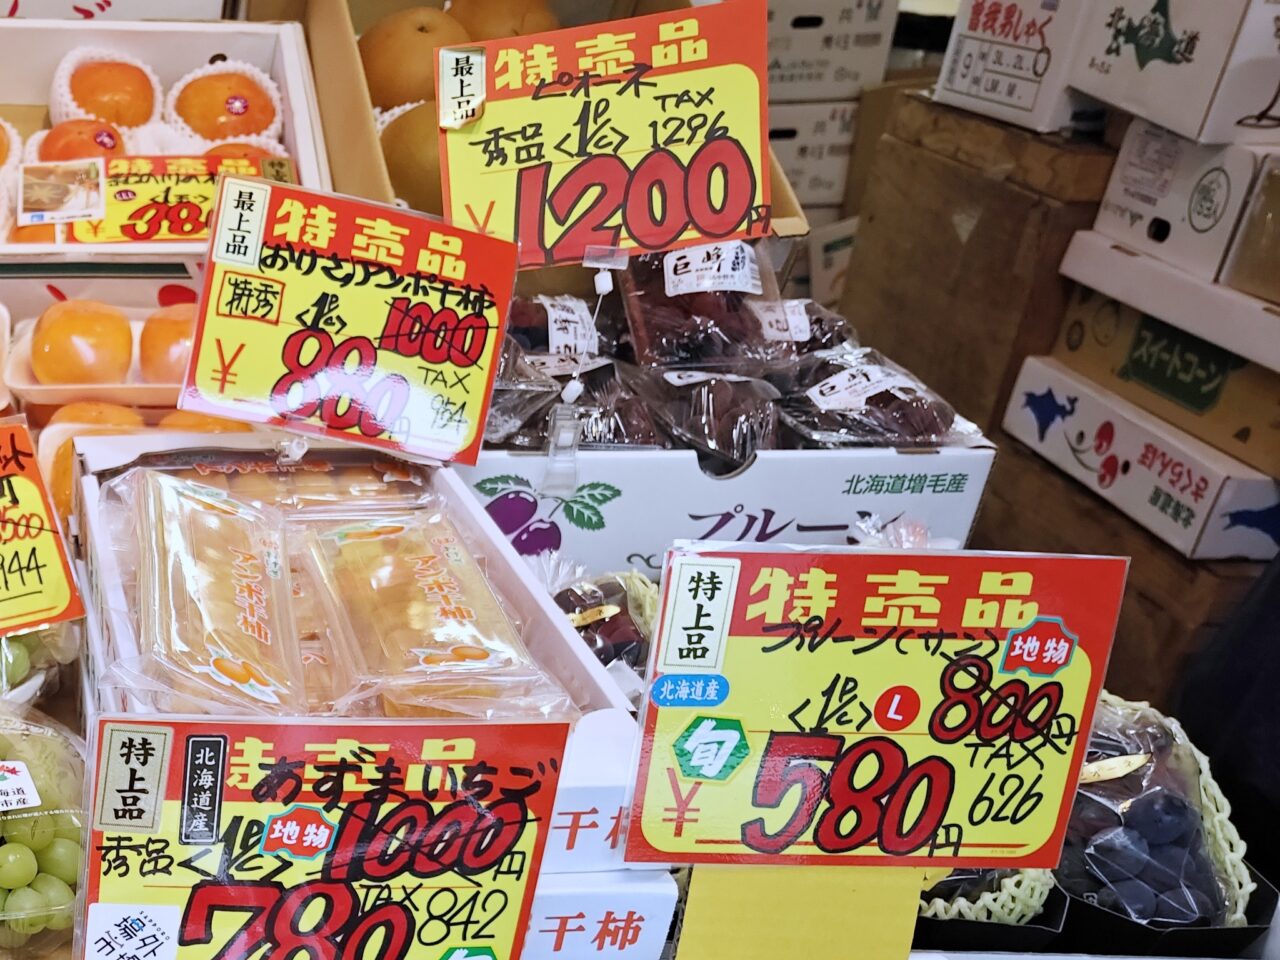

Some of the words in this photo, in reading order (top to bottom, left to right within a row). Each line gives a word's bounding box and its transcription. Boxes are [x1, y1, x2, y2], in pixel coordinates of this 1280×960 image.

[494, 18, 708, 90] 特売品
[451, 56, 477, 121] 最上品
[532, 63, 657, 99] ピオーネ
[653, 88, 715, 112] TAX
[649, 111, 730, 150] 1296
[268, 161, 287, 182] 特上
[226, 190, 257, 257] 最上品
[273, 198, 467, 281] 特売品
[227, 277, 279, 317] 特秀
[418, 366, 470, 394] TAX
[843, 473, 970, 496] 北海道増毛産
[678, 570, 724, 660] 特上品
[745, 567, 1041, 627] 特売品
[1010, 633, 1071, 666] 地物
[660, 679, 719, 702] 北海道産
[686, 724, 738, 778] 旬
[964, 741, 1045, 770] TAX
[113, 737, 155, 821] 特上品
[188, 746, 217, 832] 北海道産
[967, 773, 1044, 826] 626
[97, 835, 175, 877] 秀品
[269, 818, 331, 849] 地物
[358, 883, 424, 912] TAX
[417, 889, 509, 946] 842
[539, 911, 645, 952] 干柿
